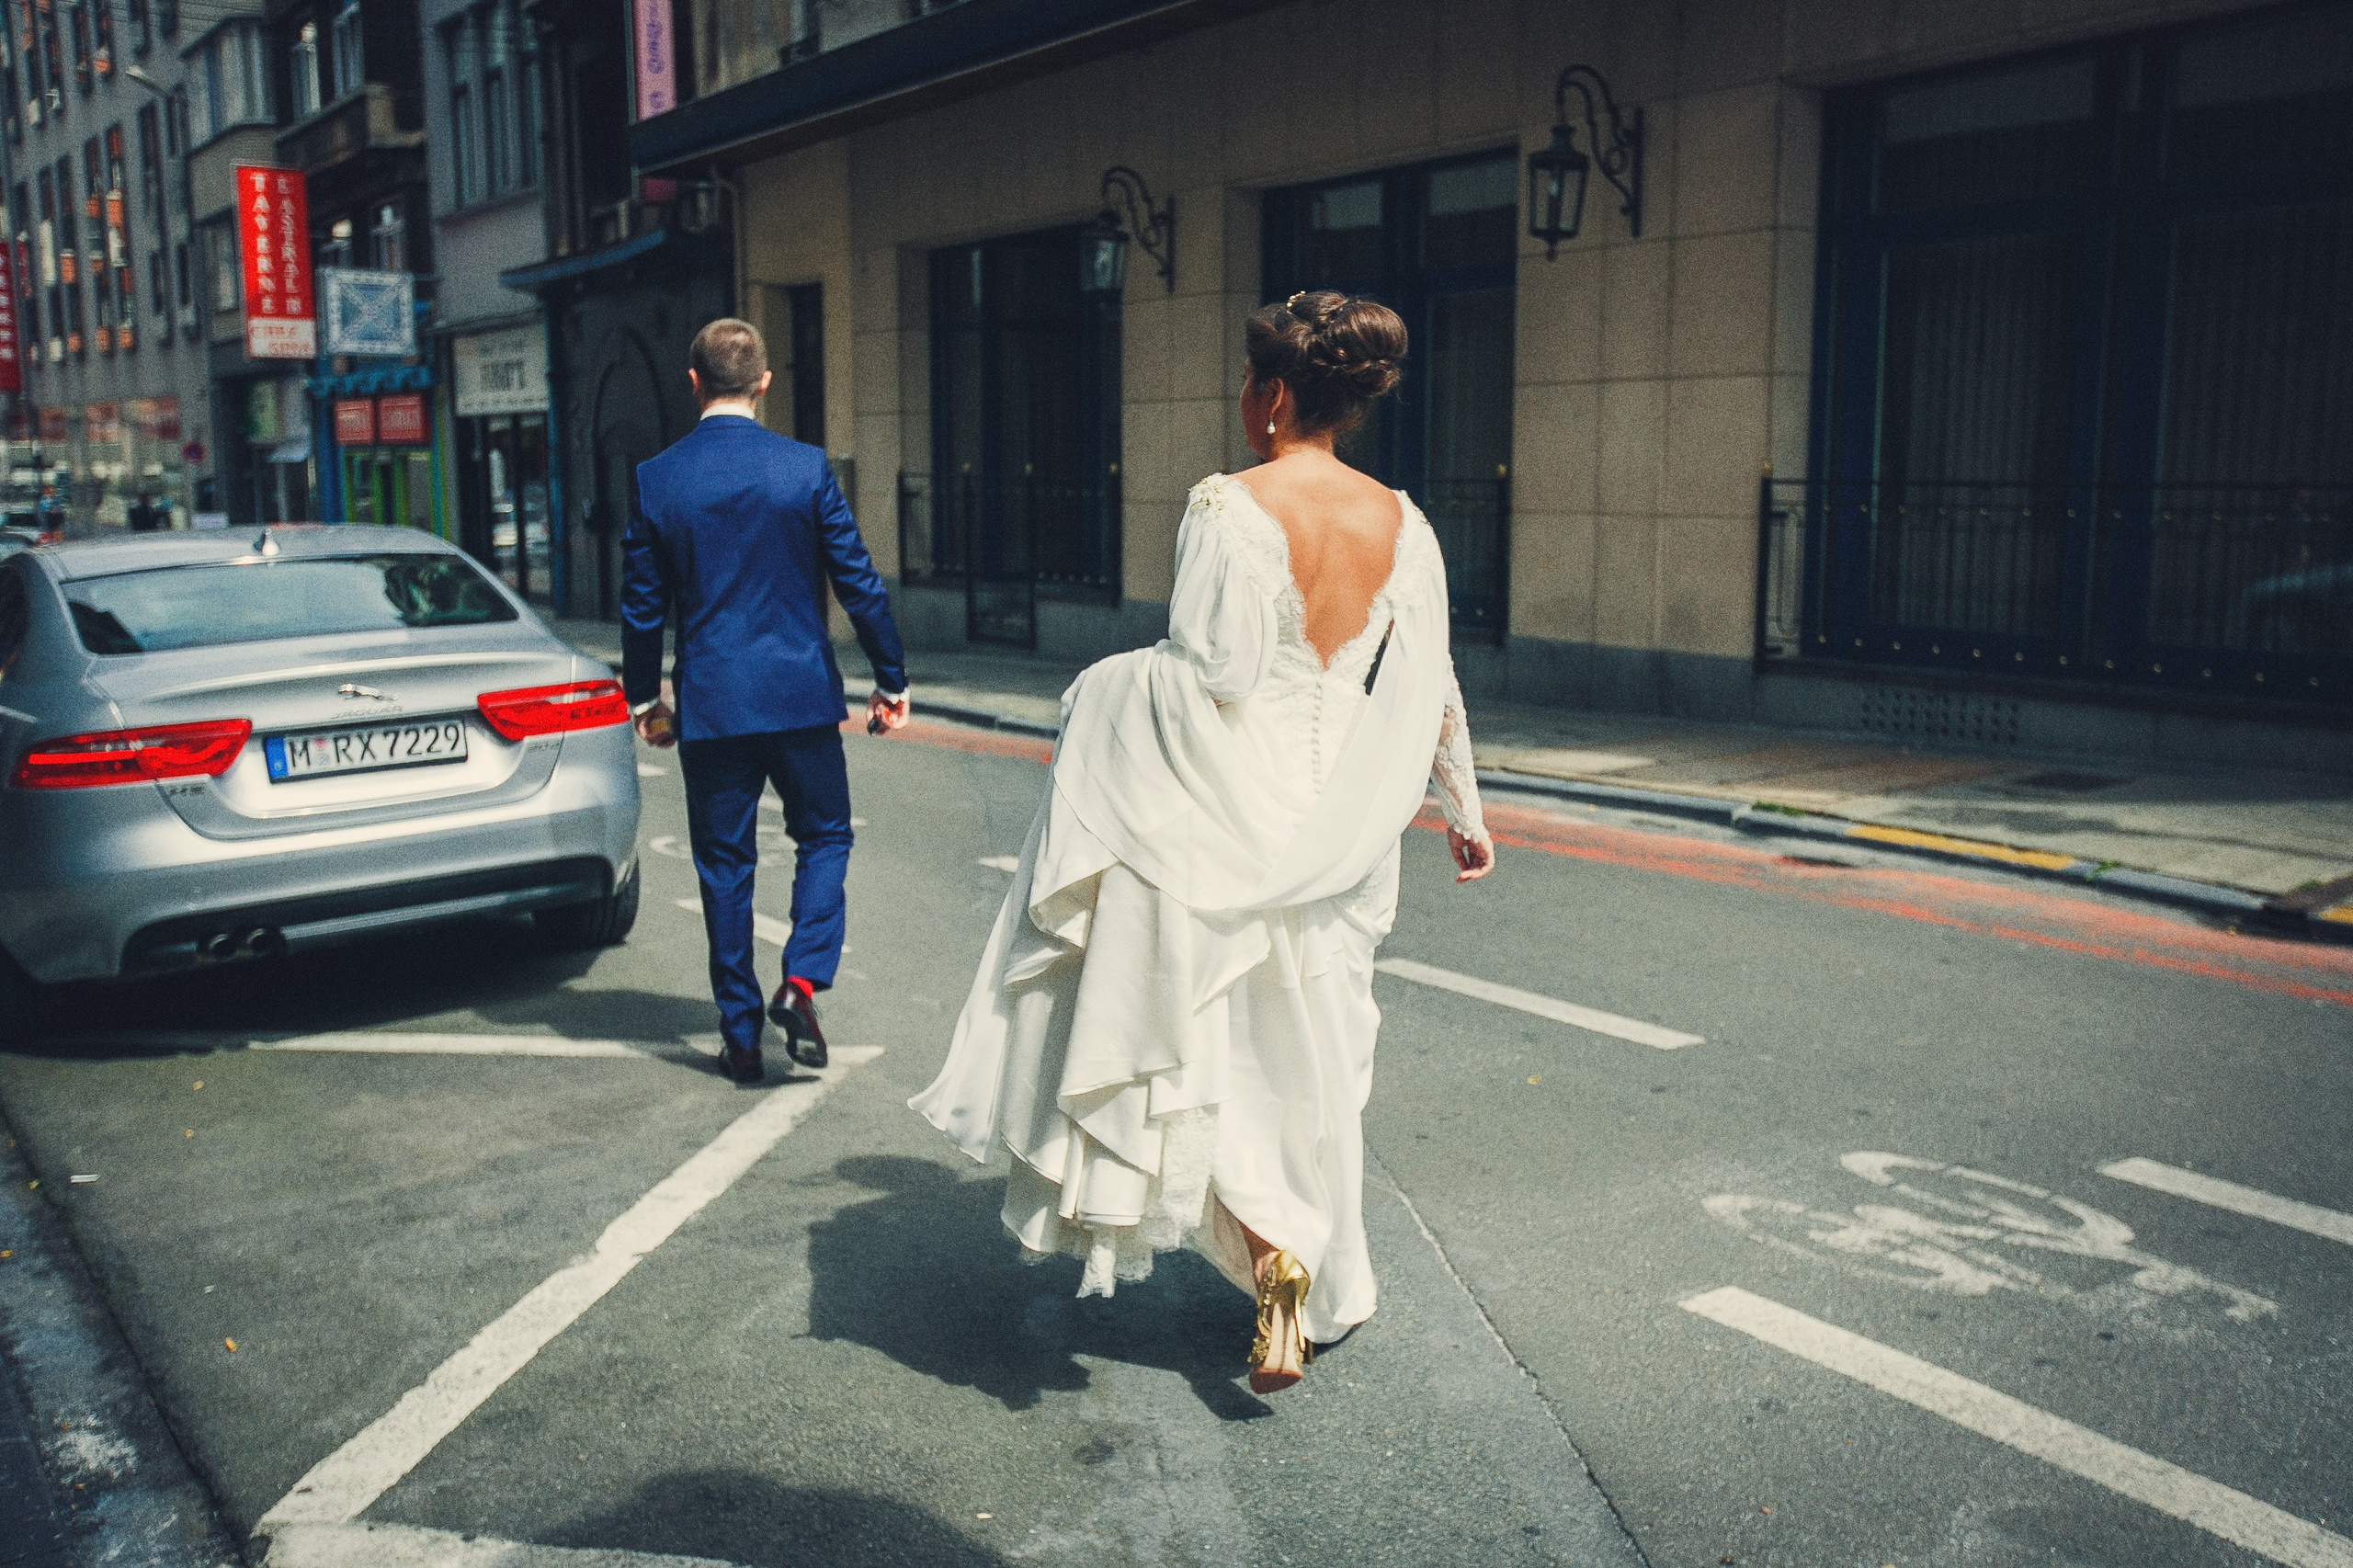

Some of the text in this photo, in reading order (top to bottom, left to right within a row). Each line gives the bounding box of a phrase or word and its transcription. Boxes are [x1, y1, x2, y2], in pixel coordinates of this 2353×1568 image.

[249, 172, 276, 314] TAVERNE
[290, 723, 460, 769] M RX 7229
